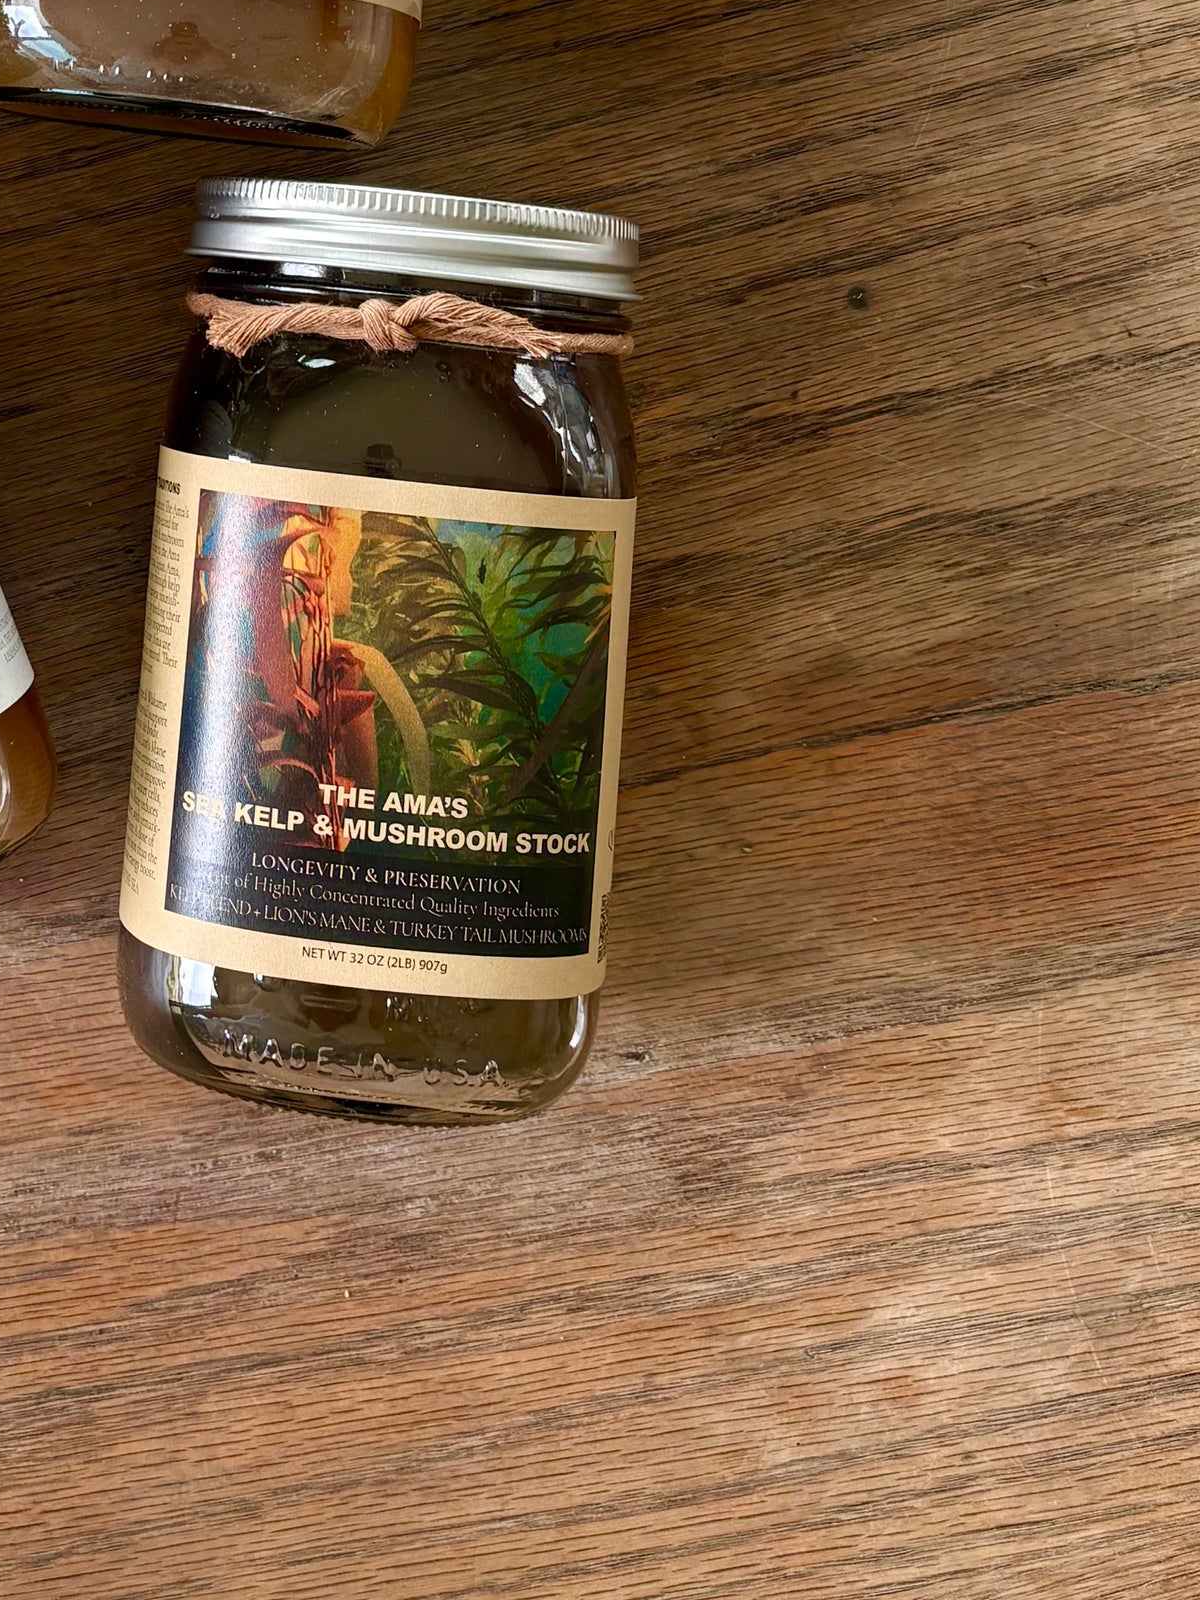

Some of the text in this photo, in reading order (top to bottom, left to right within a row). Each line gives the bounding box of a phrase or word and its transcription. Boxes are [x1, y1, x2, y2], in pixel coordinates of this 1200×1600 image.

[182, 790, 591, 854] SEA KELP & MUSHROOM STOCK
[318, 783, 468, 819] THE AMA’S
[252, 852, 360, 881] LONGEVITY
[365, 868, 378, 884] &
[384, 869, 521, 895] PRESERVATION
[234, 873, 253, 888] of
[254, 875, 305, 902] Highly
[310, 884, 415, 911] Concentrated
[420, 896, 478, 920] Quality
[483, 901, 560, 921] Ingredients
[264, 905, 316, 926] LION'S
[320, 912, 371, 933] MANE
[373, 919, 386, 935] &
[390, 919, 458, 941] TURKEY
[460, 926, 496, 943] TAIL
[500, 929, 587, 944] MUSHROOMS
[302, 946, 448, 974] NET WT 32 OZ (2LB) 907g
[223, 1027, 334, 1075] MADE
